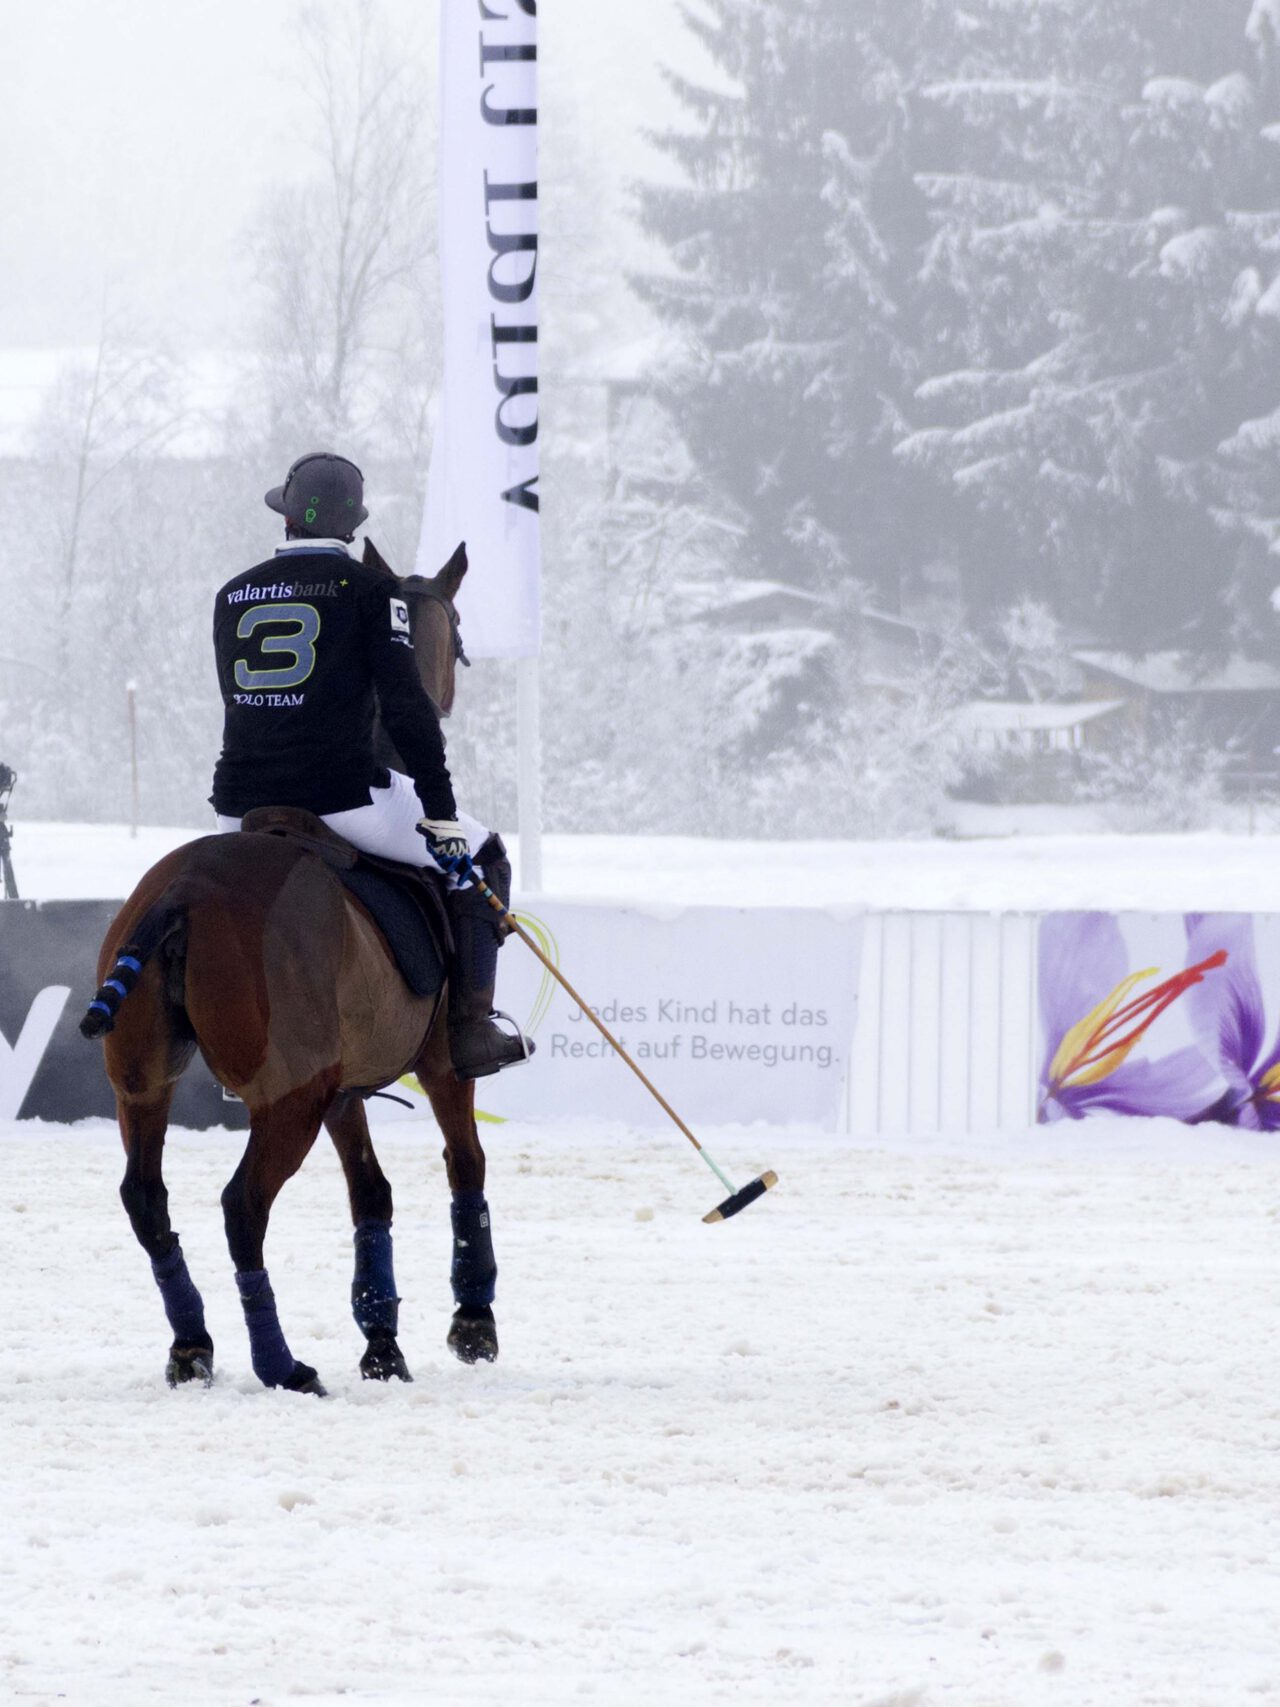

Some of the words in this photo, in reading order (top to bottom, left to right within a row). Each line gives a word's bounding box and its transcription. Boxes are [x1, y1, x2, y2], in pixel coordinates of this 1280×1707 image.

[234, 603, 321, 690] 3
[265, 693, 305, 707] TEAM
[658, 999, 717, 1024] Kind
[729, 1000, 772, 1025] hat
[781, 1002, 829, 1027] das
[637, 1034, 682, 1059] auf
[691, 1035, 841, 1068] Bewegung.
